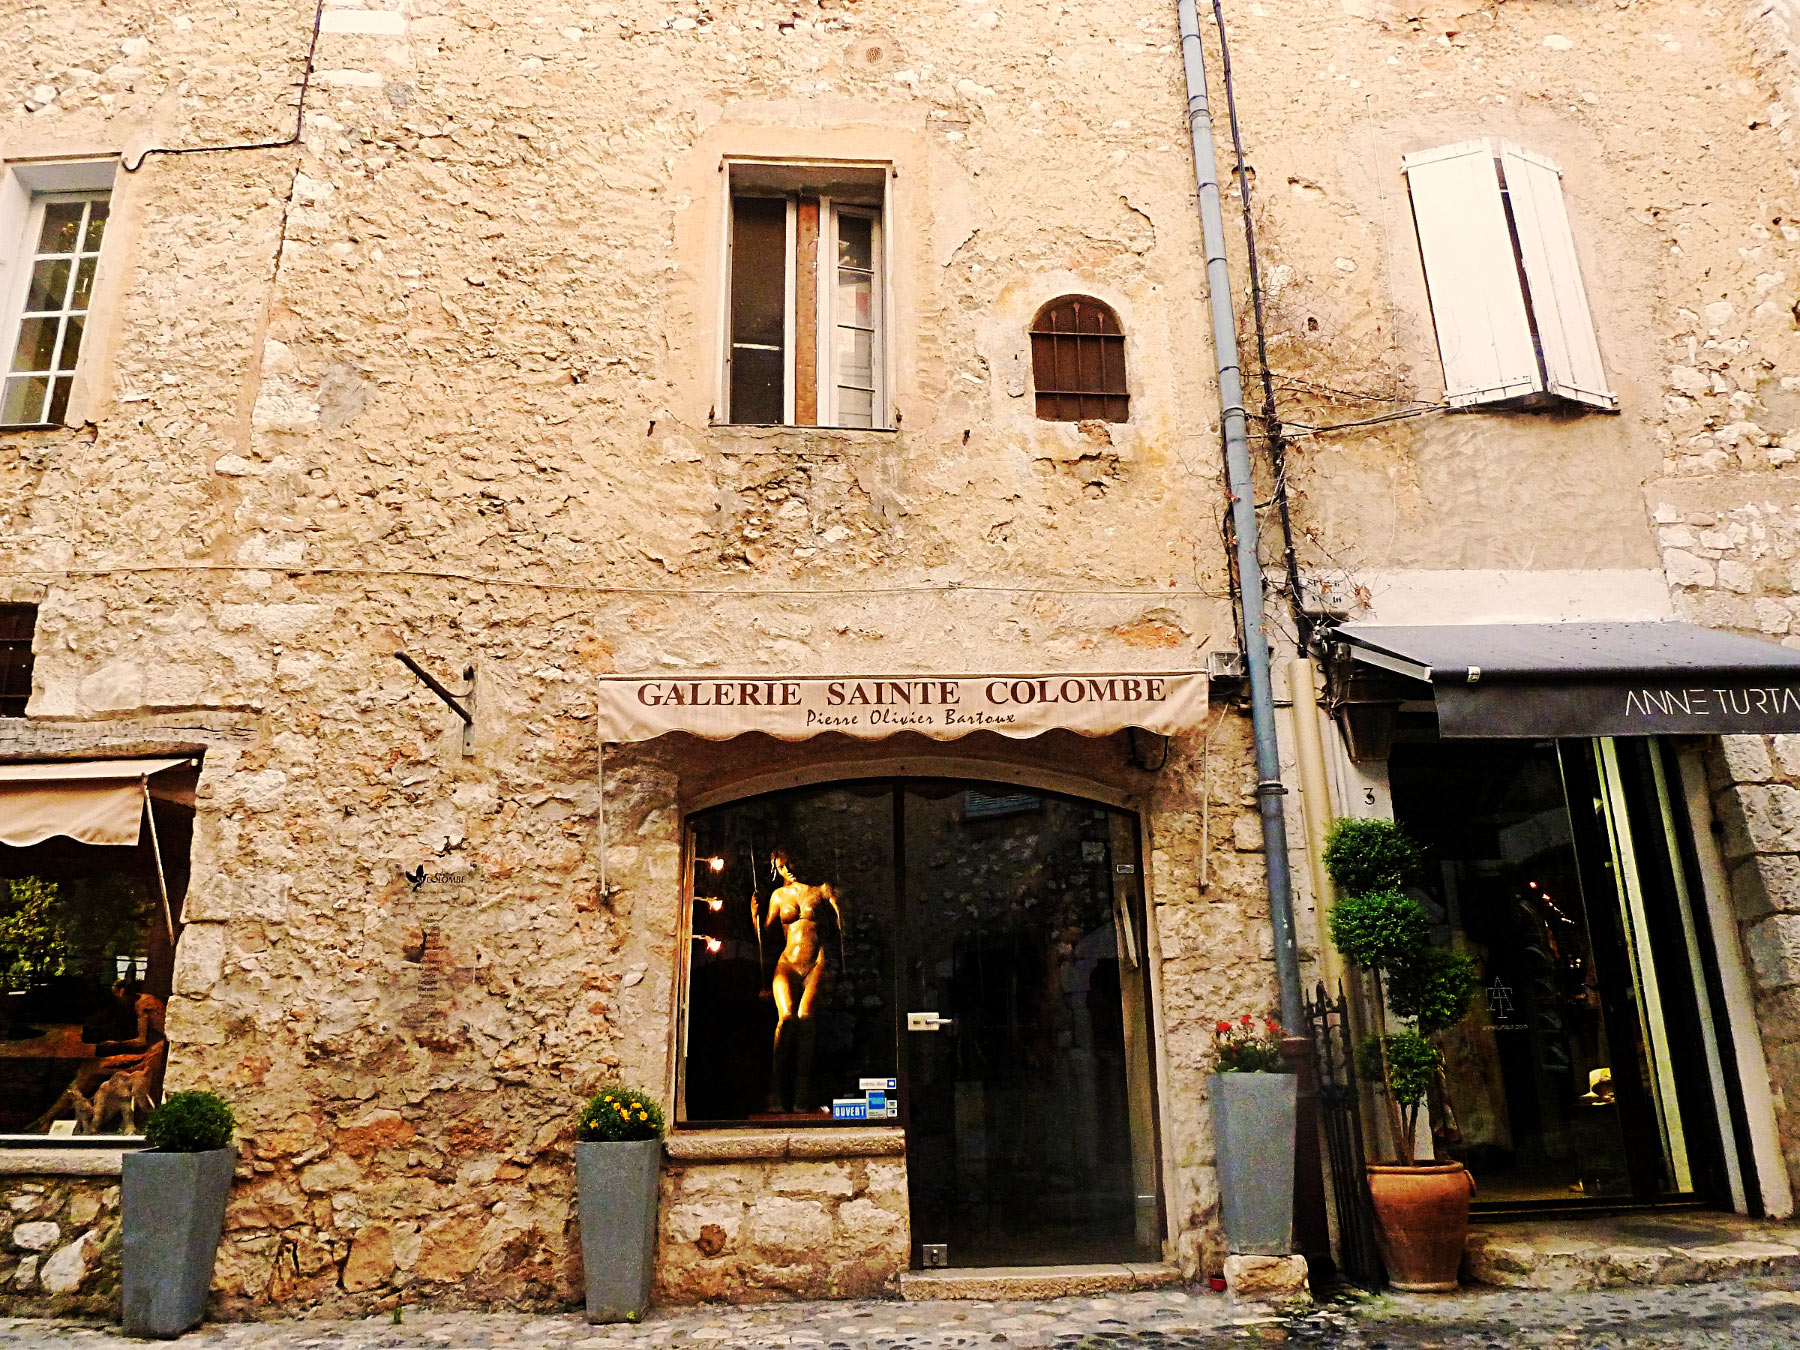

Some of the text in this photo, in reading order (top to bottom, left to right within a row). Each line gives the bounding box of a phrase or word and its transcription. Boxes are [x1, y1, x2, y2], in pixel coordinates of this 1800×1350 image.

[637, 679, 1167, 705] GALERIE SAINTE COLOMBE
[1625, 688, 1709, 716] ANNE
[807, 708, 1017, 728] Pierre Olivier Bartoux
[1361, 787, 1376, 806] 3
[835, 1106, 867, 1118] OUVERT
